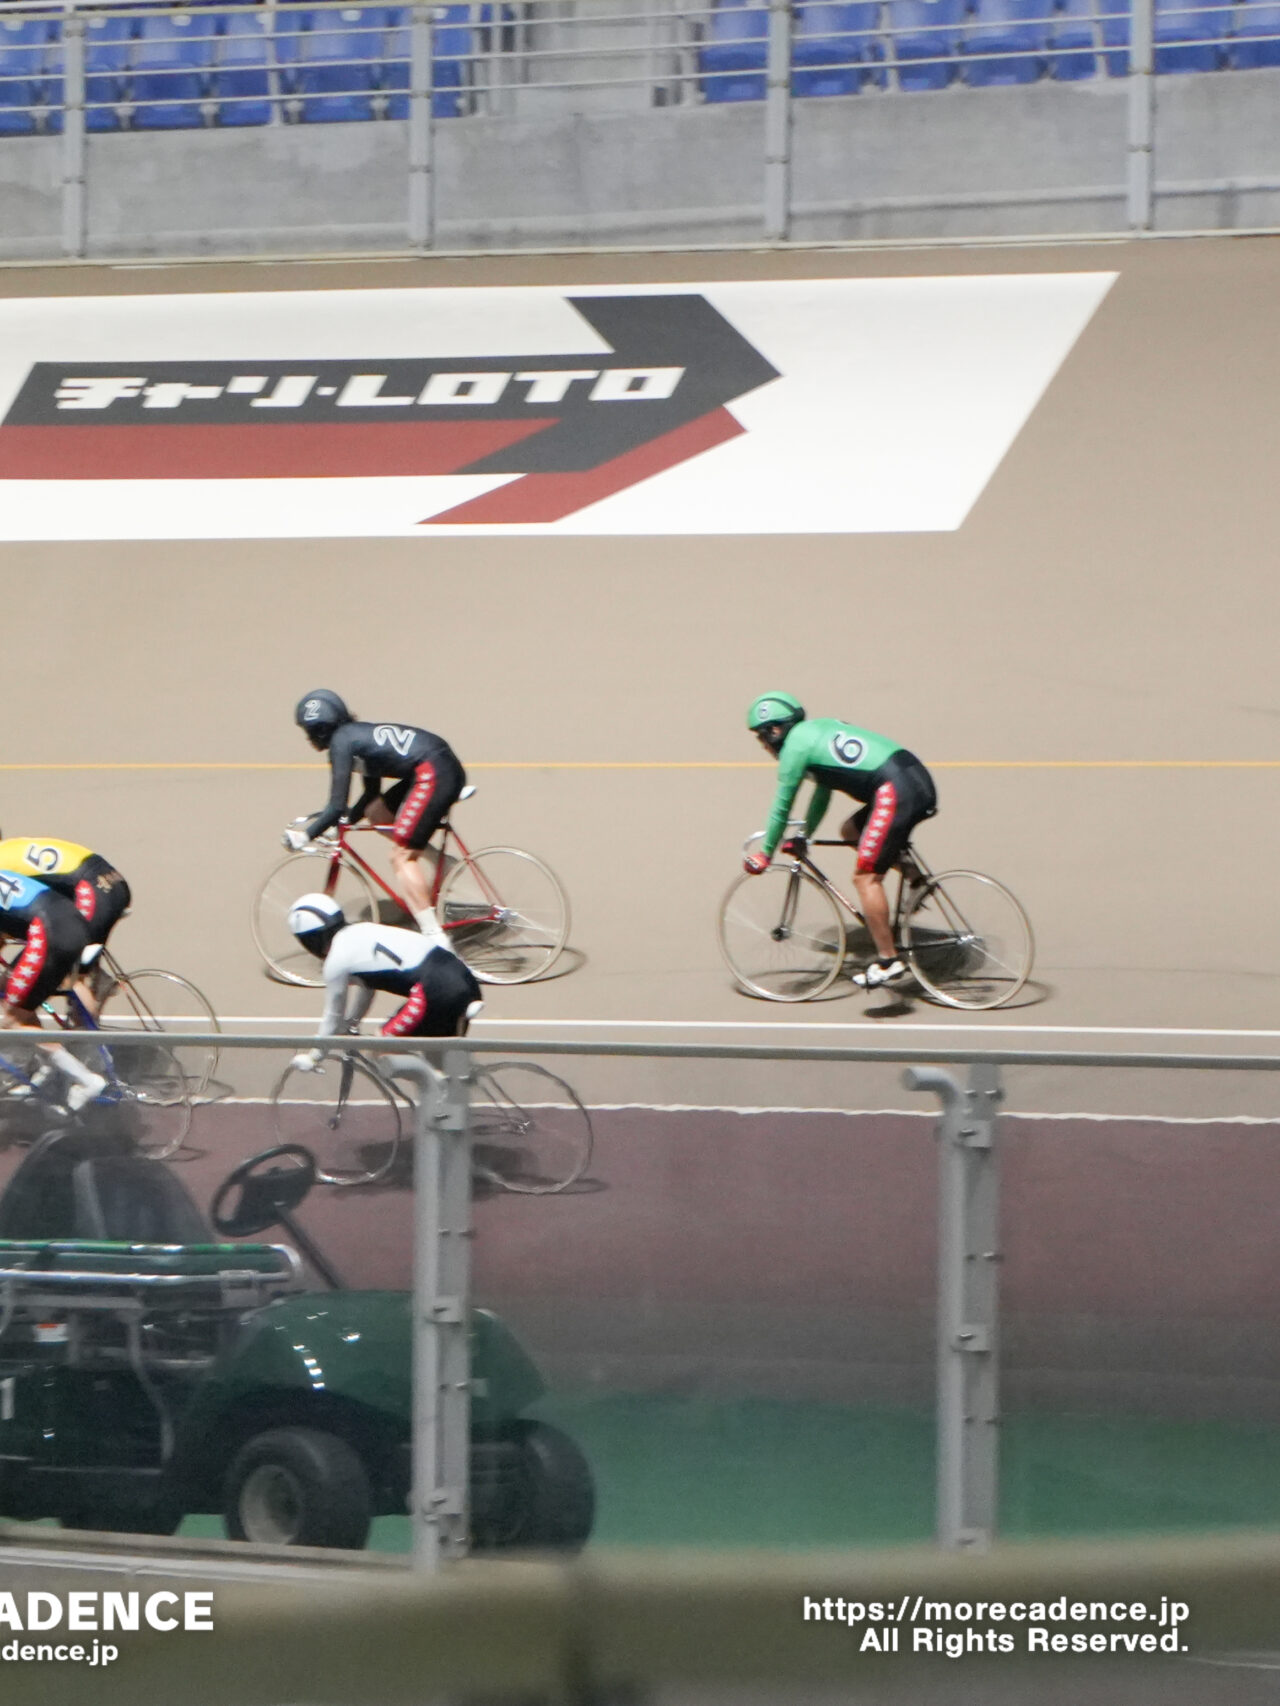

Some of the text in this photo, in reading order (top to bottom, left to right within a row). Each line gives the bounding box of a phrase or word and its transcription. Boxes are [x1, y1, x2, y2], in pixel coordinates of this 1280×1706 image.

[304, 699, 320, 721] 2
[373, 725, 416, 756] 2
[830, 732, 866, 767] 6
[25, 844, 61, 872] 5
[374, 941, 403, 967] 1
